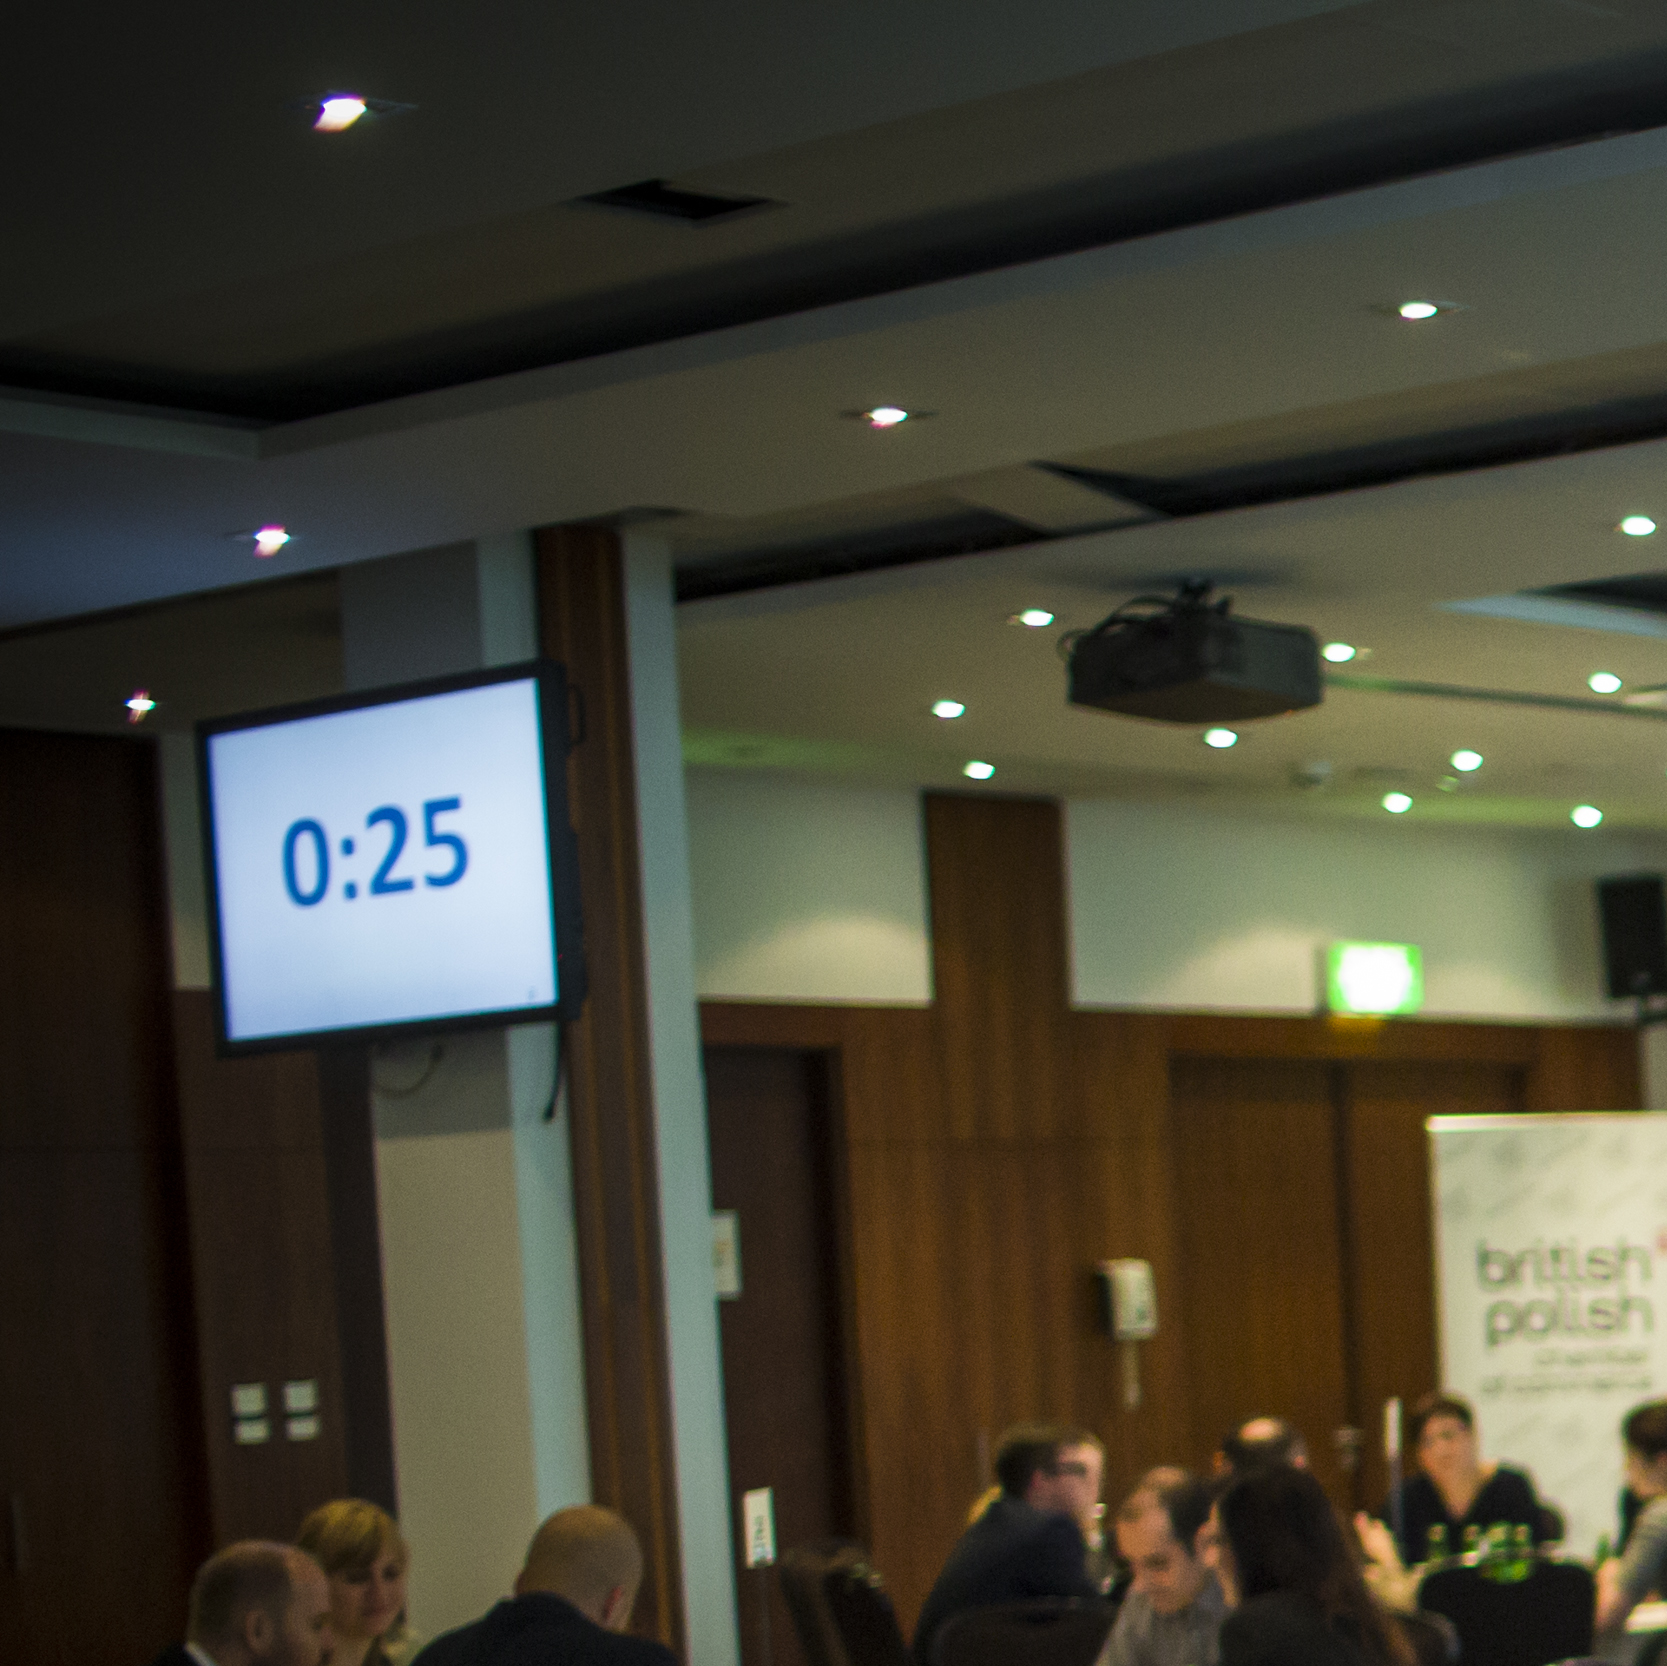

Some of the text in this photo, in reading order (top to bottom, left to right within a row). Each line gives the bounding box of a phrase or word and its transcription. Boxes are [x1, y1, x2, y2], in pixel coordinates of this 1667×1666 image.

[281, 795, 471, 908] 0:25
[1476, 1236, 1653, 1293] british
[1486, 1285, 1656, 1353] polish
